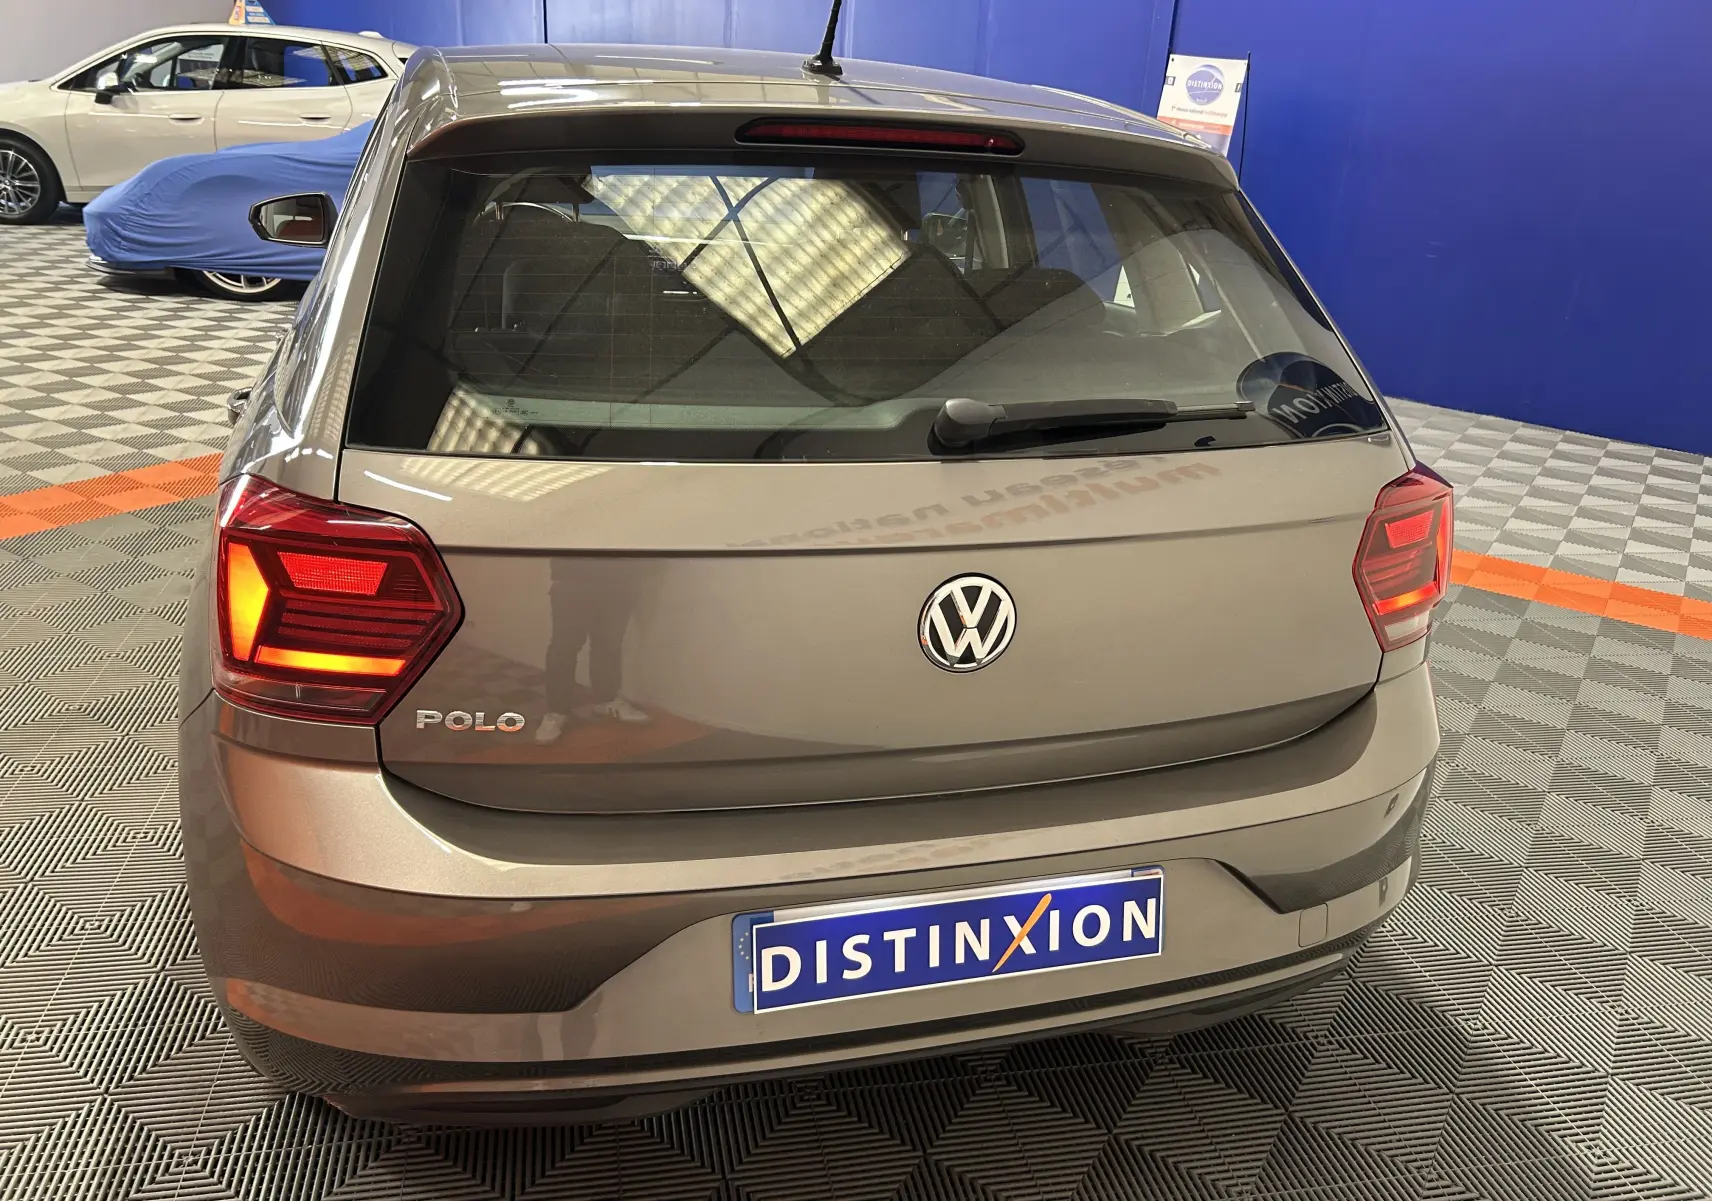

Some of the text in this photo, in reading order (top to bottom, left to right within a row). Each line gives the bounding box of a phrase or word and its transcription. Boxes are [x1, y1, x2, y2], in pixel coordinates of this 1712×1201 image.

[1187, 78, 1223, 91] DISTINXION
[416, 709, 526, 732] POLO
[761, 893, 1157, 992] DISTINXION
